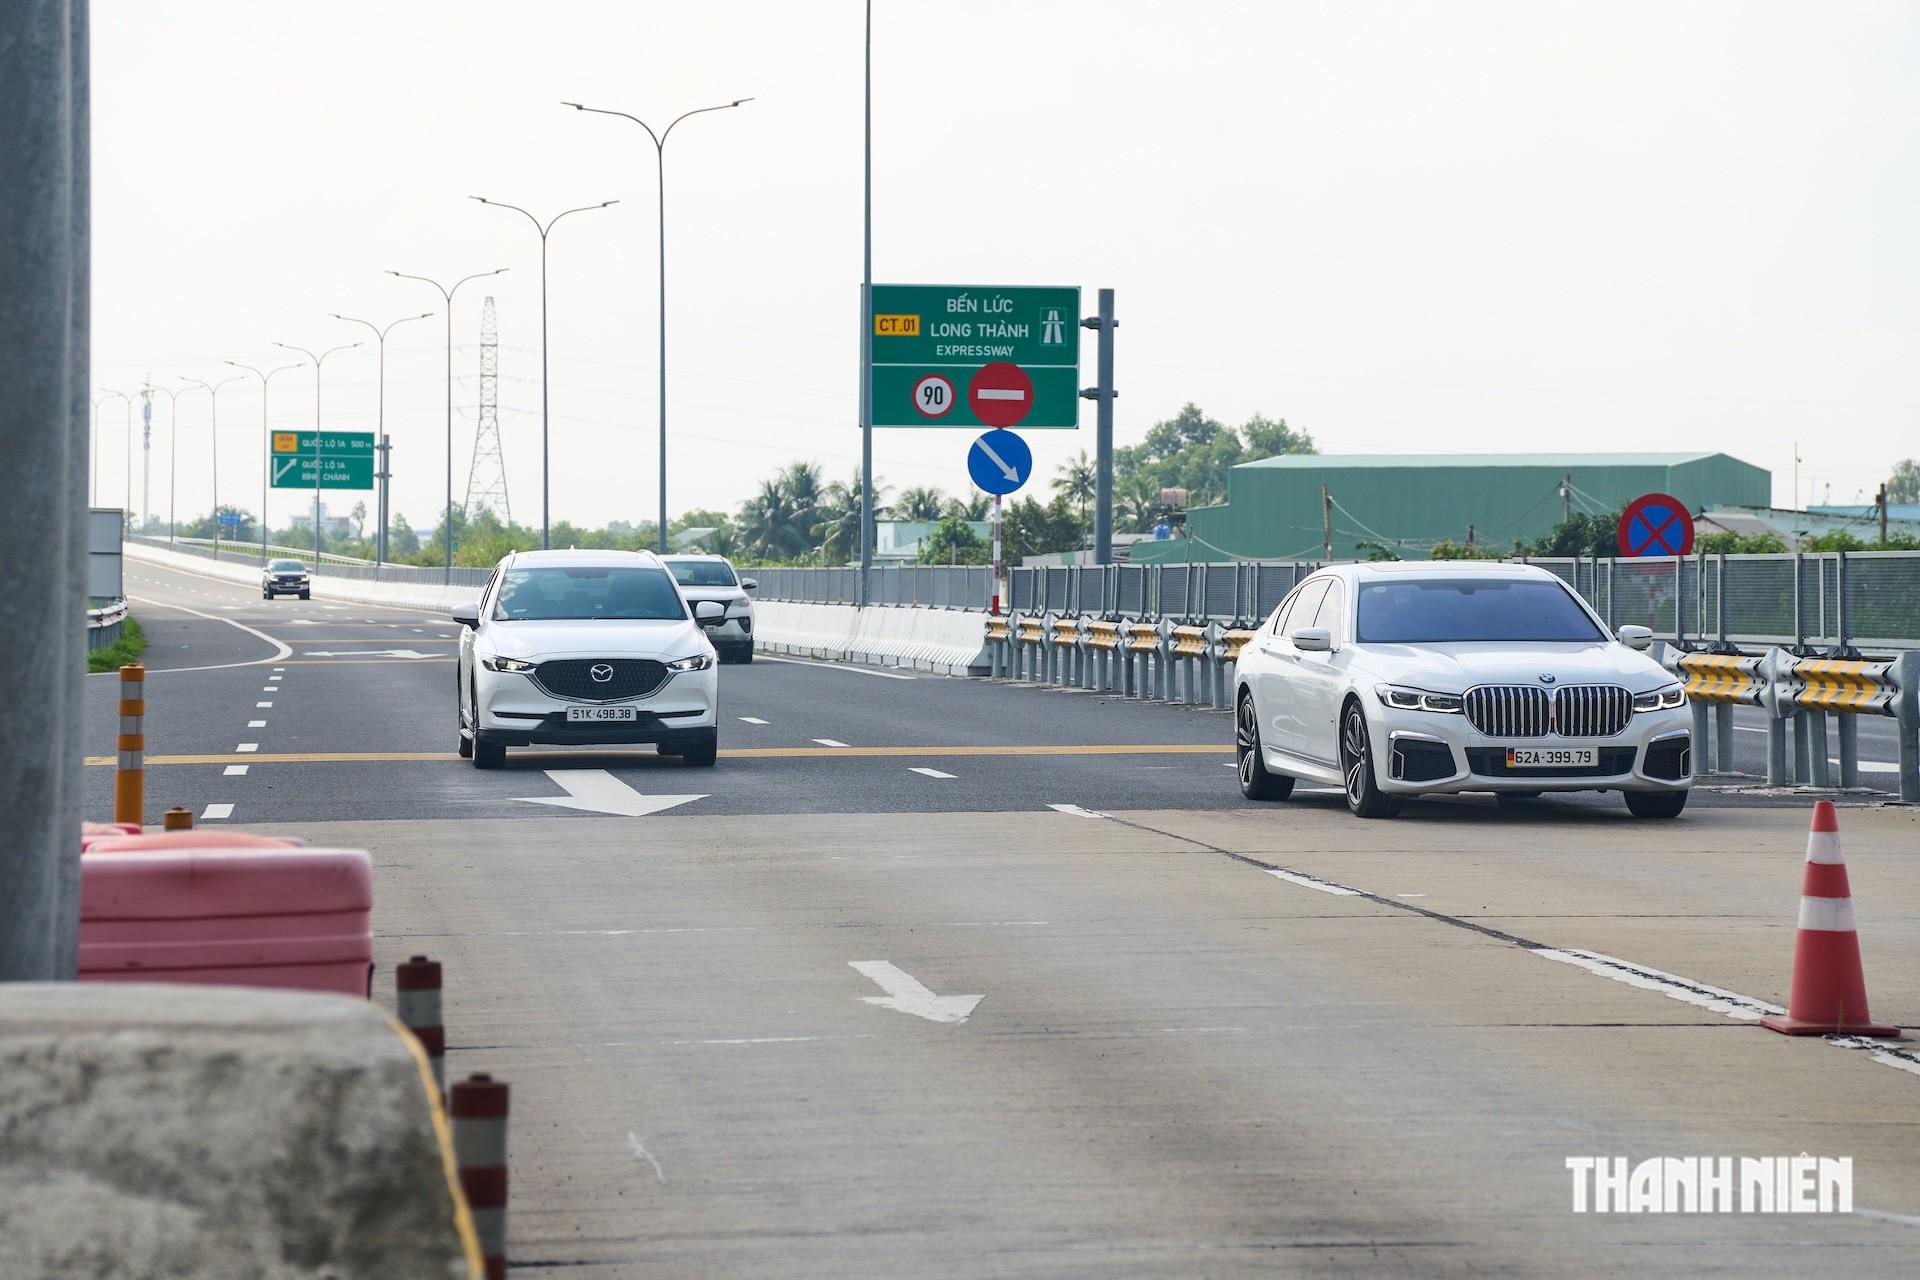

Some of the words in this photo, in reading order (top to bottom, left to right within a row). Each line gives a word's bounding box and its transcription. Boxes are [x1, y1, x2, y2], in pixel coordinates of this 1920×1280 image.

[947, 293, 977, 313] BẾN
[984, 295, 1013, 313] LỨC
[879, 318, 916, 332] CT.01
[931, 323, 972, 338] LONG
[977, 320, 1029, 338] THÀNH
[936, 345, 1014, 356] EXPRESSWAY
[924, 386, 944, 406] 90
[337, 440, 346, 448] 1A
[351, 440, 364, 448] 500
[1515, 751, 1591, 763] 62A-399.79
